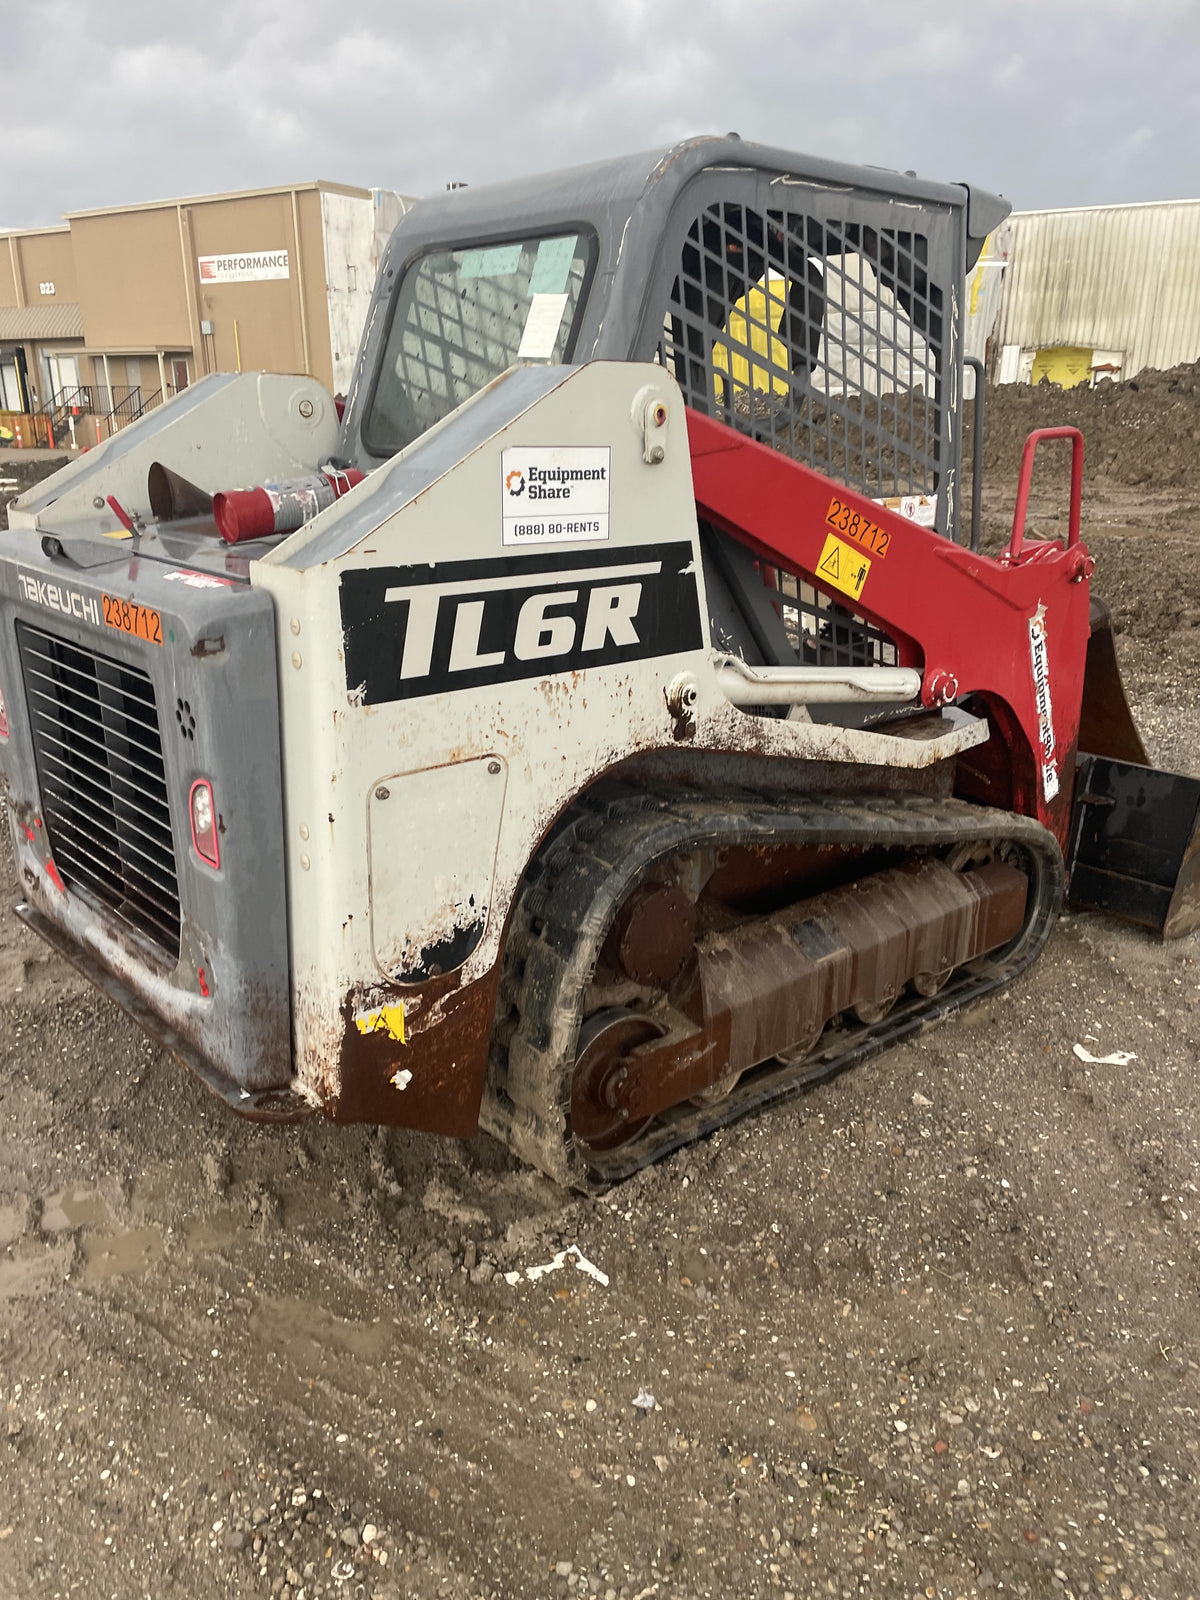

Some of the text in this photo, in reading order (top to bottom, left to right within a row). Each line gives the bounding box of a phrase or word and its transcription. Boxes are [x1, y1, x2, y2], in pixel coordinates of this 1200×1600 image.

[217, 255, 288, 271] PERFORMANCE
[40, 282, 55, 295] D23
[528, 467, 606, 484] Equipment
[528, 485, 571, 499] Share
[514, 522, 600, 536] (888) 80-RENTS
[827, 500, 890, 556] 238712
[103, 595, 162, 644] 238712
[384, 560, 662, 680] TL6R
